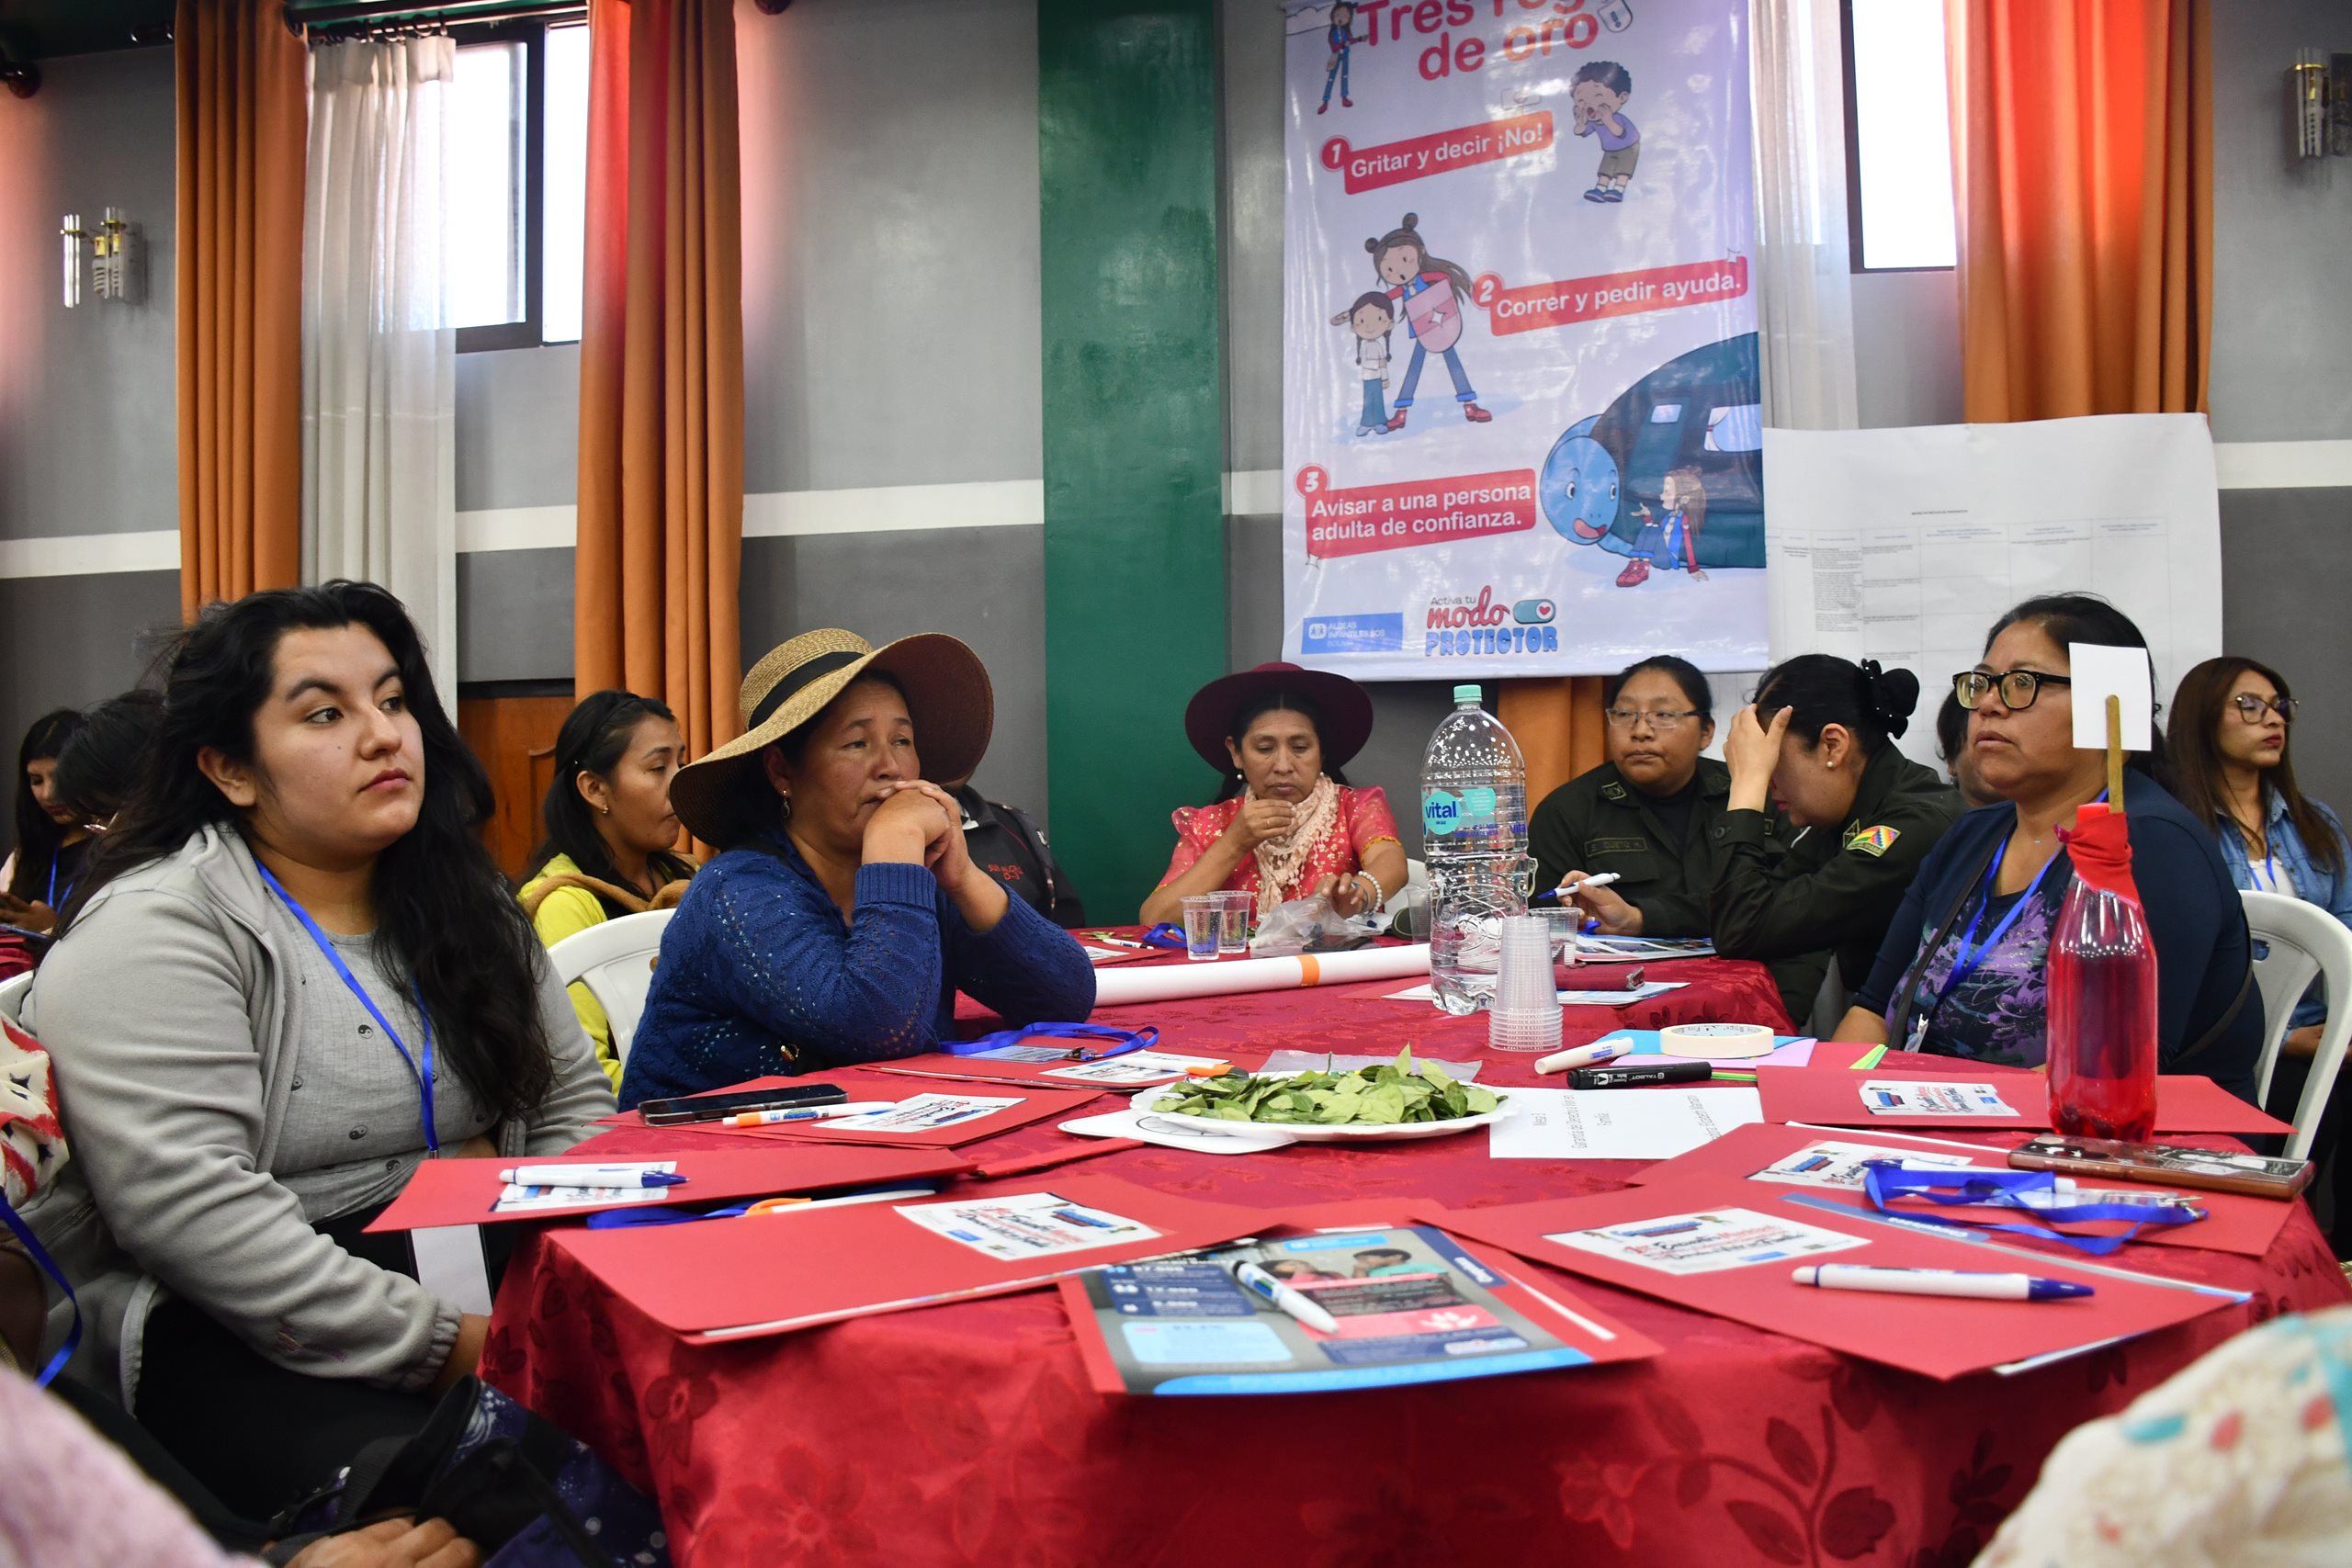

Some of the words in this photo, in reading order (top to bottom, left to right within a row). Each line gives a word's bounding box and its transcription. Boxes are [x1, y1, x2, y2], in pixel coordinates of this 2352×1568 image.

[1419, 32, 1486, 81] de
[1503, 13, 1600, 62] oro
[1351, 152, 1412, 178] Gritar
[1417, 150, 1430, 170] y
[1435, 136, 1491, 162] decir
[1498, 122, 1544, 154] ¡No!
[1497, 293, 1569, 319] Correr
[1575, 291, 1589, 313] y
[1595, 281, 1657, 310] pedir
[1662, 272, 1742, 301] ayuda.
[1311, 498, 1376, 518] Avisar
[1382, 497, 1394, 512] a
[1399, 492, 1438, 511] una
[1443, 484, 1532, 511] persona
[1312, 521, 1376, 541] adulta
[1381, 517, 1408, 536] de
[1412, 510, 1522, 534] confianza.
[1427, 585, 1510, 629] modo
[1430, 595, 1464, 606] Activa
[1465, 594, 1476, 604] tu
[1425, 626, 1558, 656] PROTECTOR
[1425, 800, 1459, 819] vital
[1631, 1073, 1657, 1081] TALBOT
